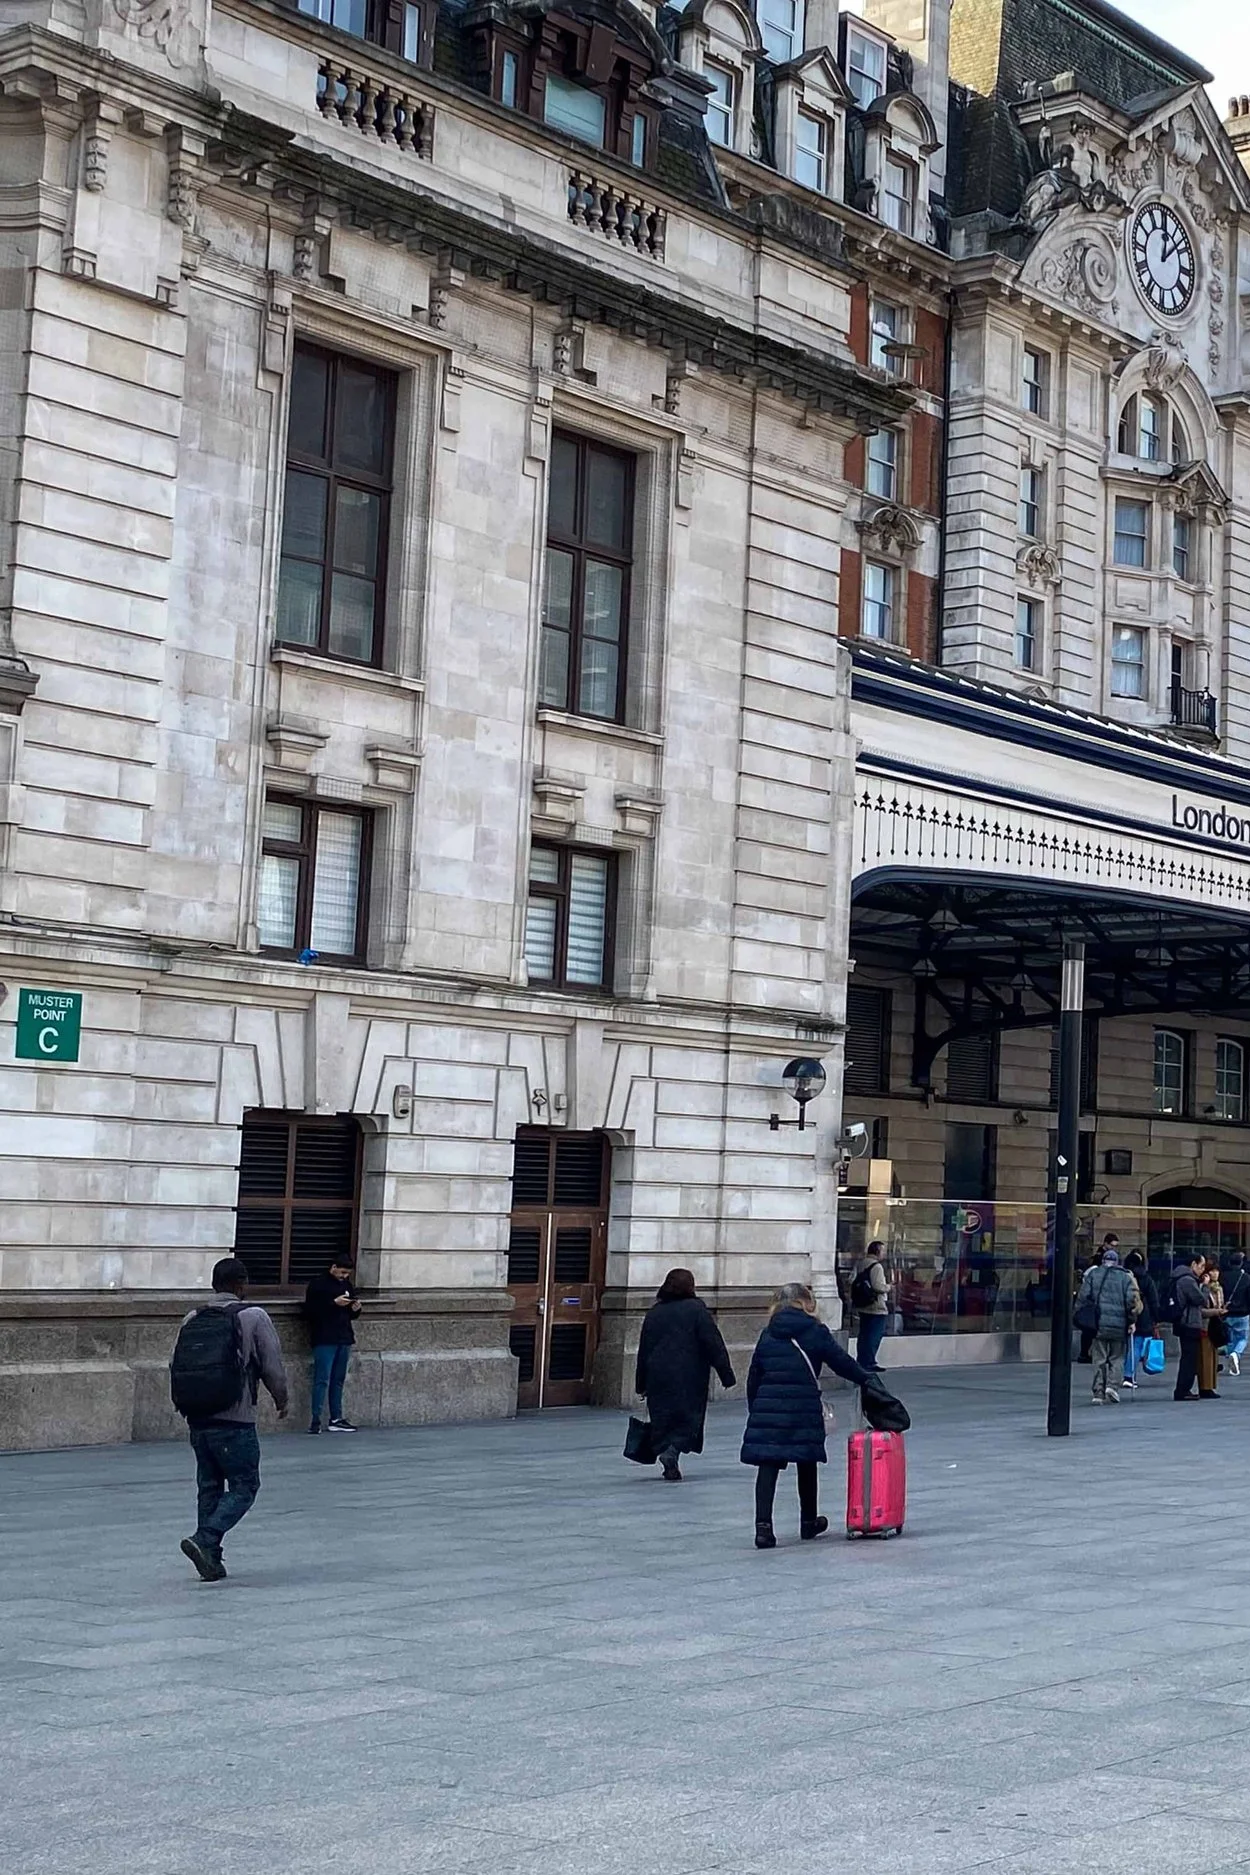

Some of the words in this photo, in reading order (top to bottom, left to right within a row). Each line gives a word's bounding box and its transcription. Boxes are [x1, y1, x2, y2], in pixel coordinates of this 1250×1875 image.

[28, 994, 74, 1009] MUSTER
[33, 1008, 67, 1022] POINT
[38, 1026, 59, 1053] C
